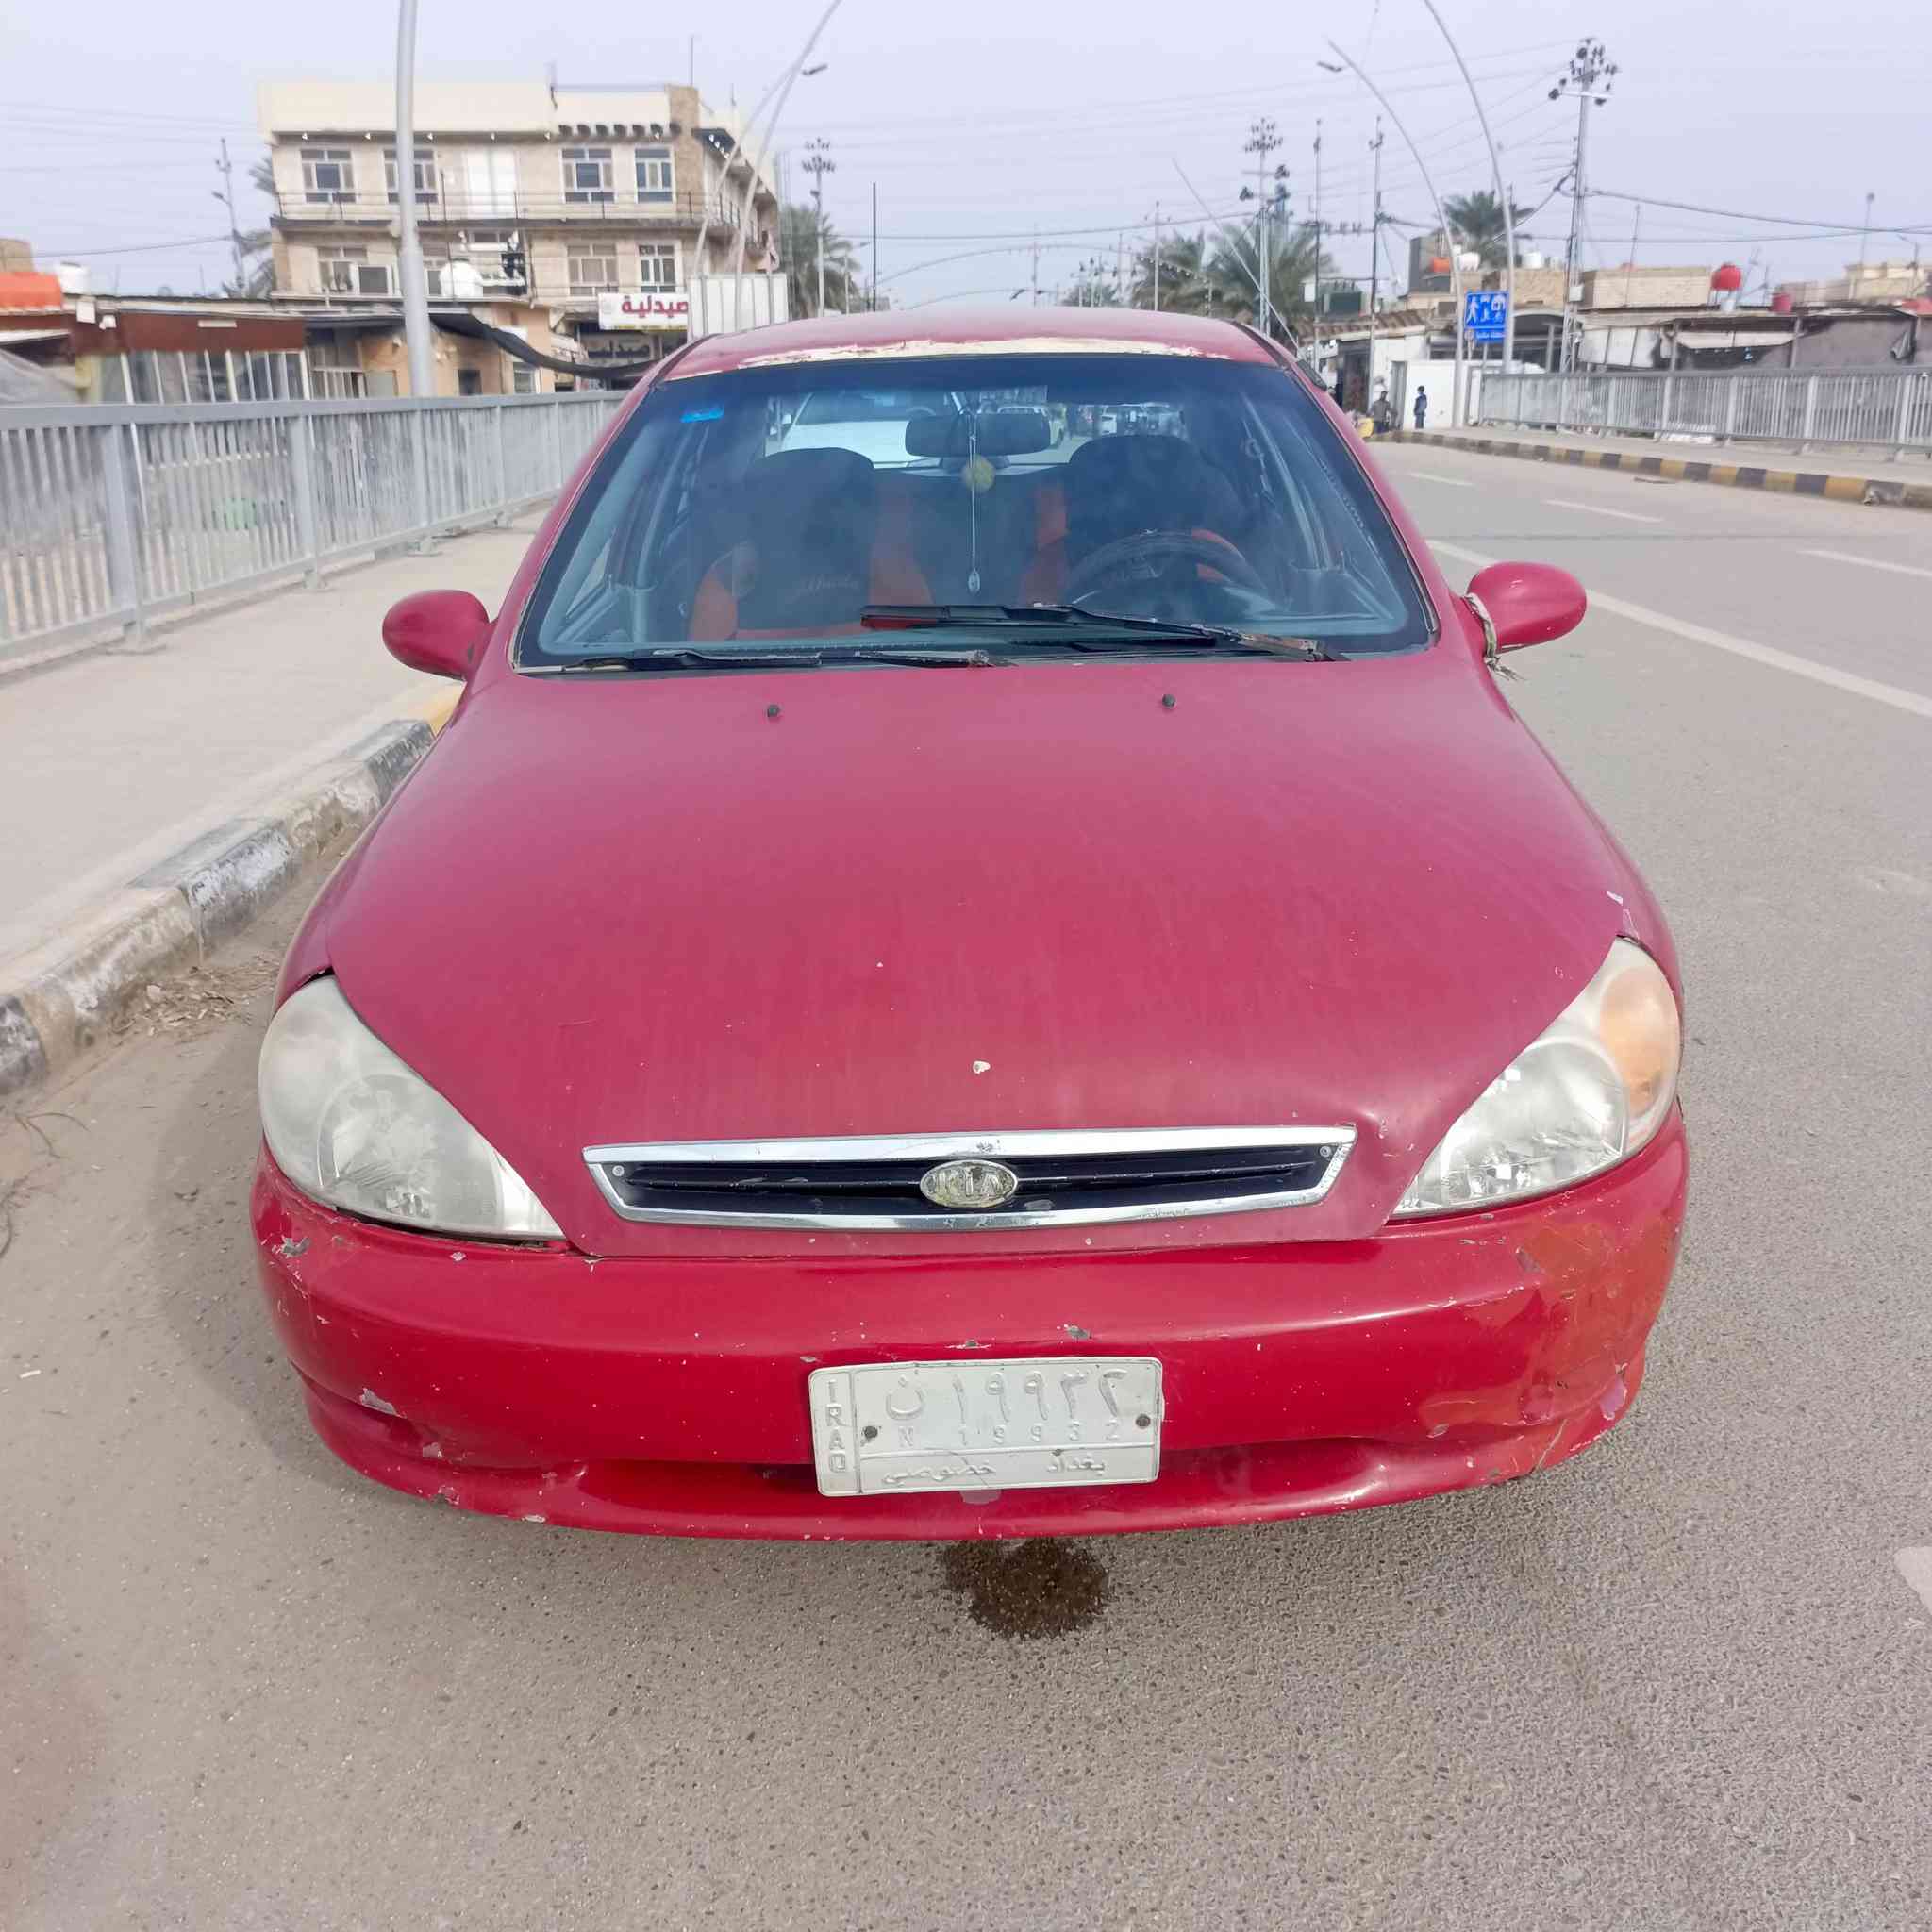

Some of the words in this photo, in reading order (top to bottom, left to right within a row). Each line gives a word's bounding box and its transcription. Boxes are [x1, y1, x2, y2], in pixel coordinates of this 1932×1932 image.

[621, 294, 689, 319] صيدلية
[825, 1377, 847, 1474] IRAQ
[1046, 1453, 1106, 1476] بغداد
